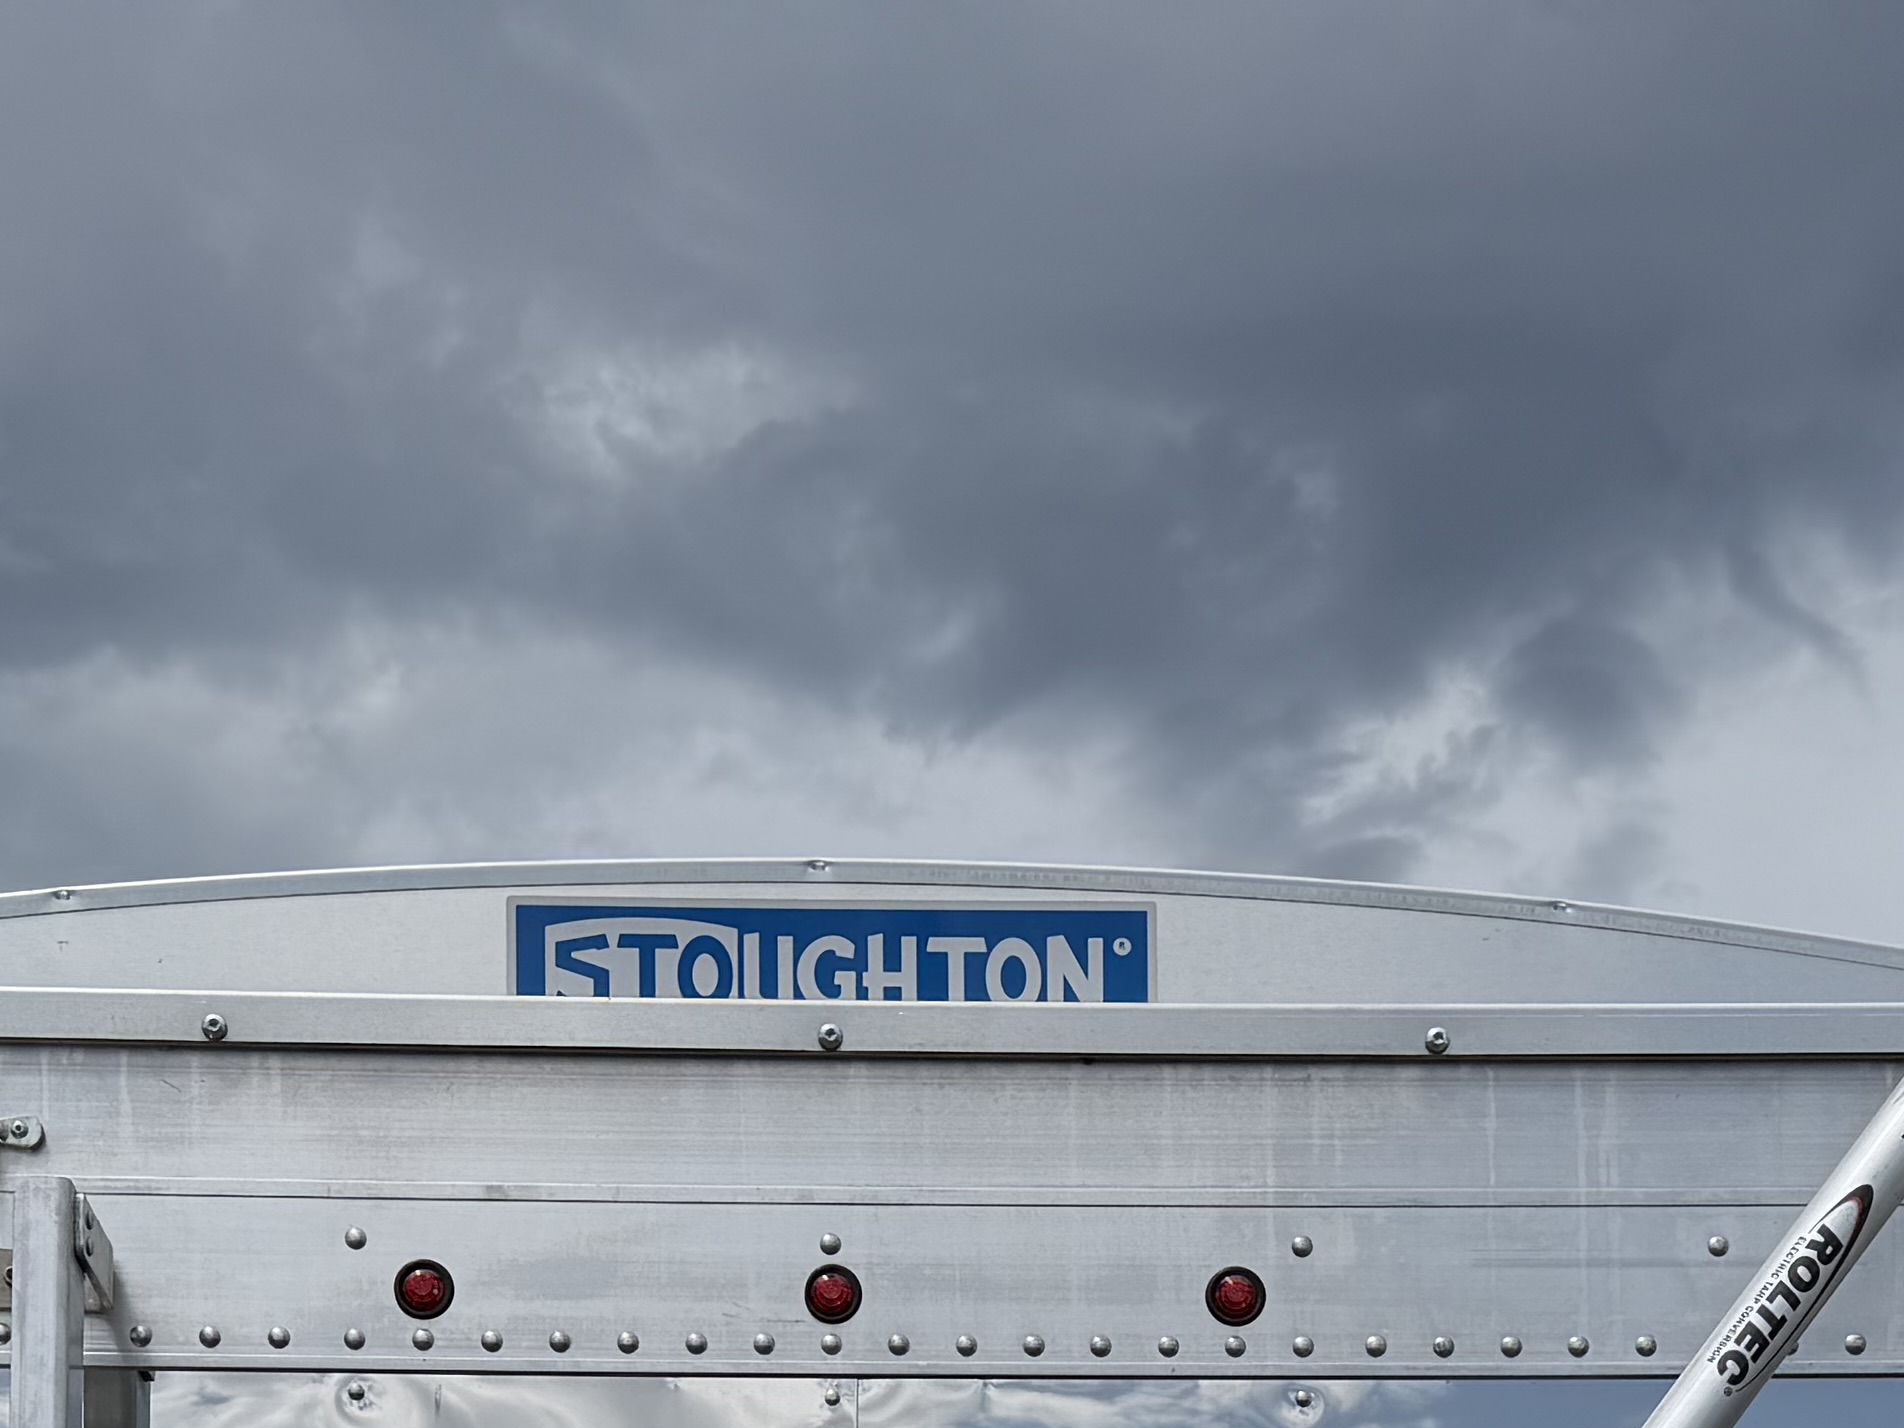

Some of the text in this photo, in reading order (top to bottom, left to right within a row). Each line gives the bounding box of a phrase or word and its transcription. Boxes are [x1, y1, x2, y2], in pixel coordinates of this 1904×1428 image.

[551, 930, 1104, 1001] STOUGHTON
[1707, 1235, 1807, 1365] ELECTRIC TARP CONVERSION
[1717, 1224, 1844, 1387] ROLTEC
